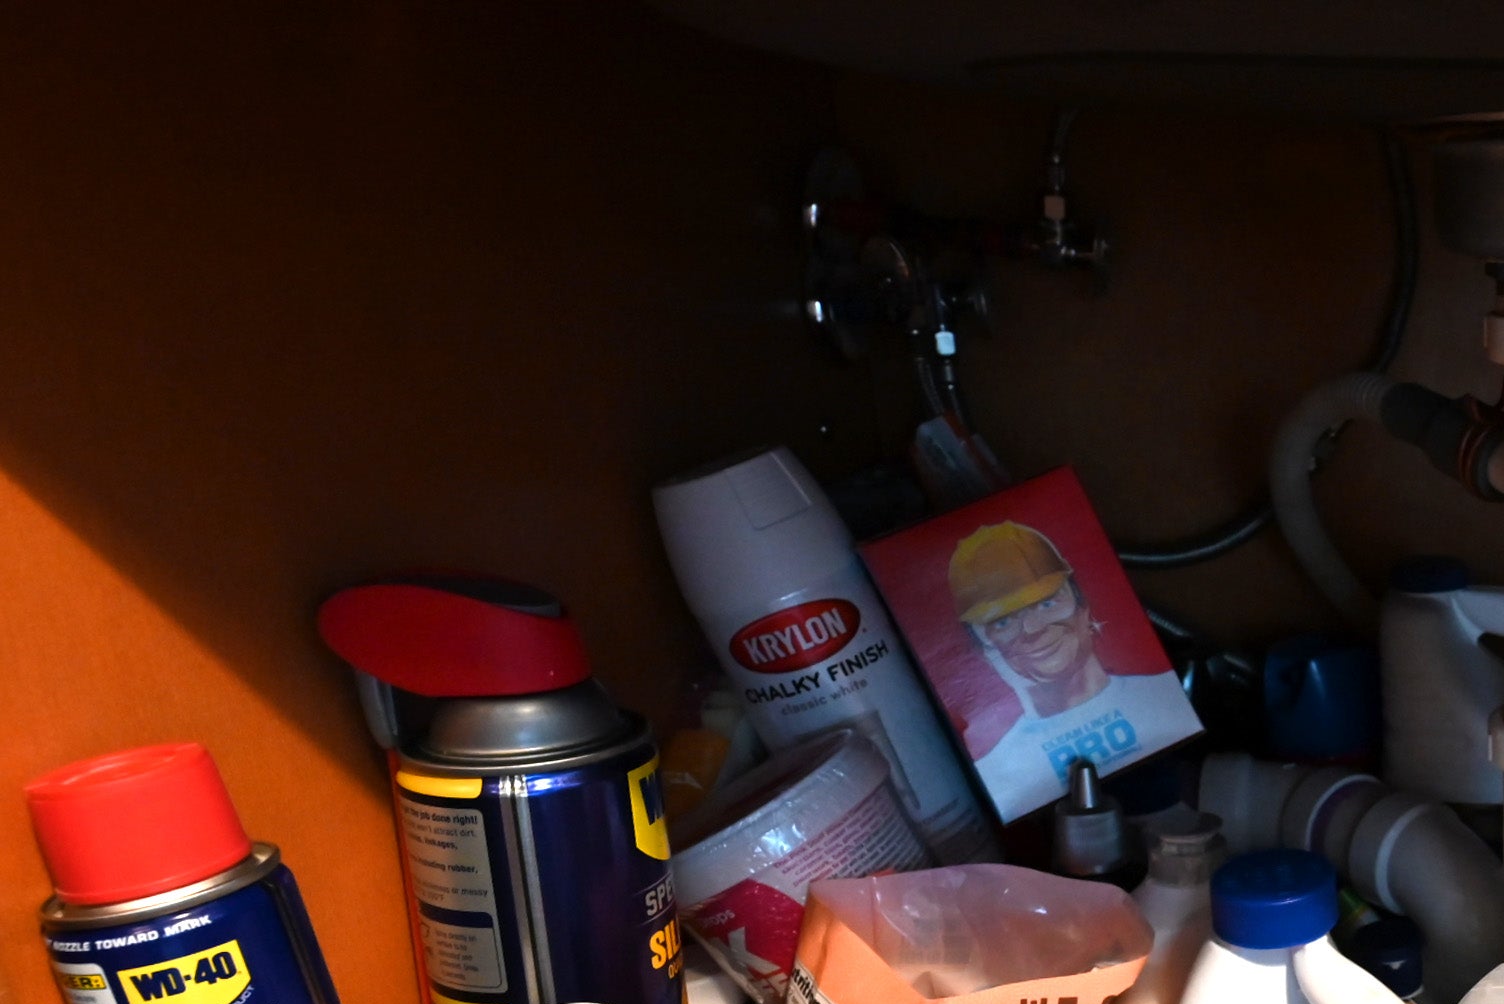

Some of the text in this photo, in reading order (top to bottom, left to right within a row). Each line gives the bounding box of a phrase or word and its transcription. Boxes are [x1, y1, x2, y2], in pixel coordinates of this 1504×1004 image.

[743, 608, 847, 664] KRYLON
[745, 640, 889, 703] CHALKY FINISH
[782, 679, 867, 715] classic white
[1047, 719, 1137, 778] PRO
[452, 815, 478, 826] right!
[447, 864, 479, 874] rubber,
[95, 930, 160, 951] TOWARD
[164, 914, 213, 938] MARK
[130, 951, 237, 1001] WD-40
